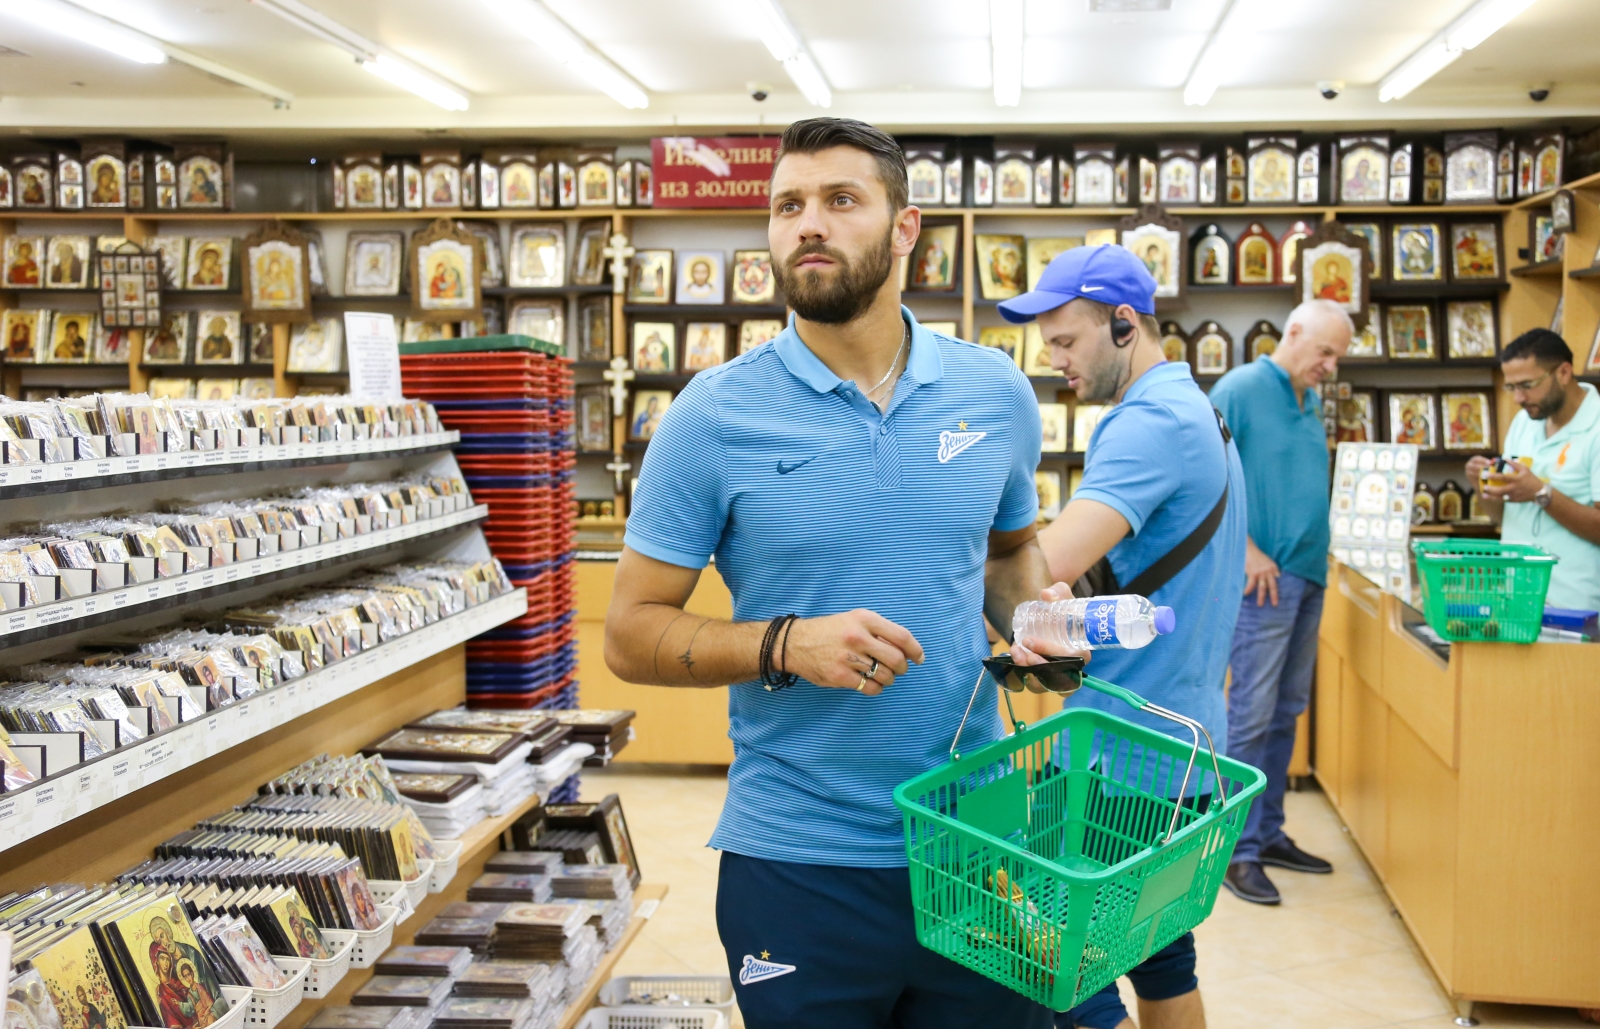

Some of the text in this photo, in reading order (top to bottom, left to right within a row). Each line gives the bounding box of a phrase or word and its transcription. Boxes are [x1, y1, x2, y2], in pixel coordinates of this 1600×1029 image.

[660, 181, 690, 198] из
[941, 434, 981, 460] Зенит
[1094, 603, 1115, 641] Spark
[742, 959, 787, 981] Зенит
